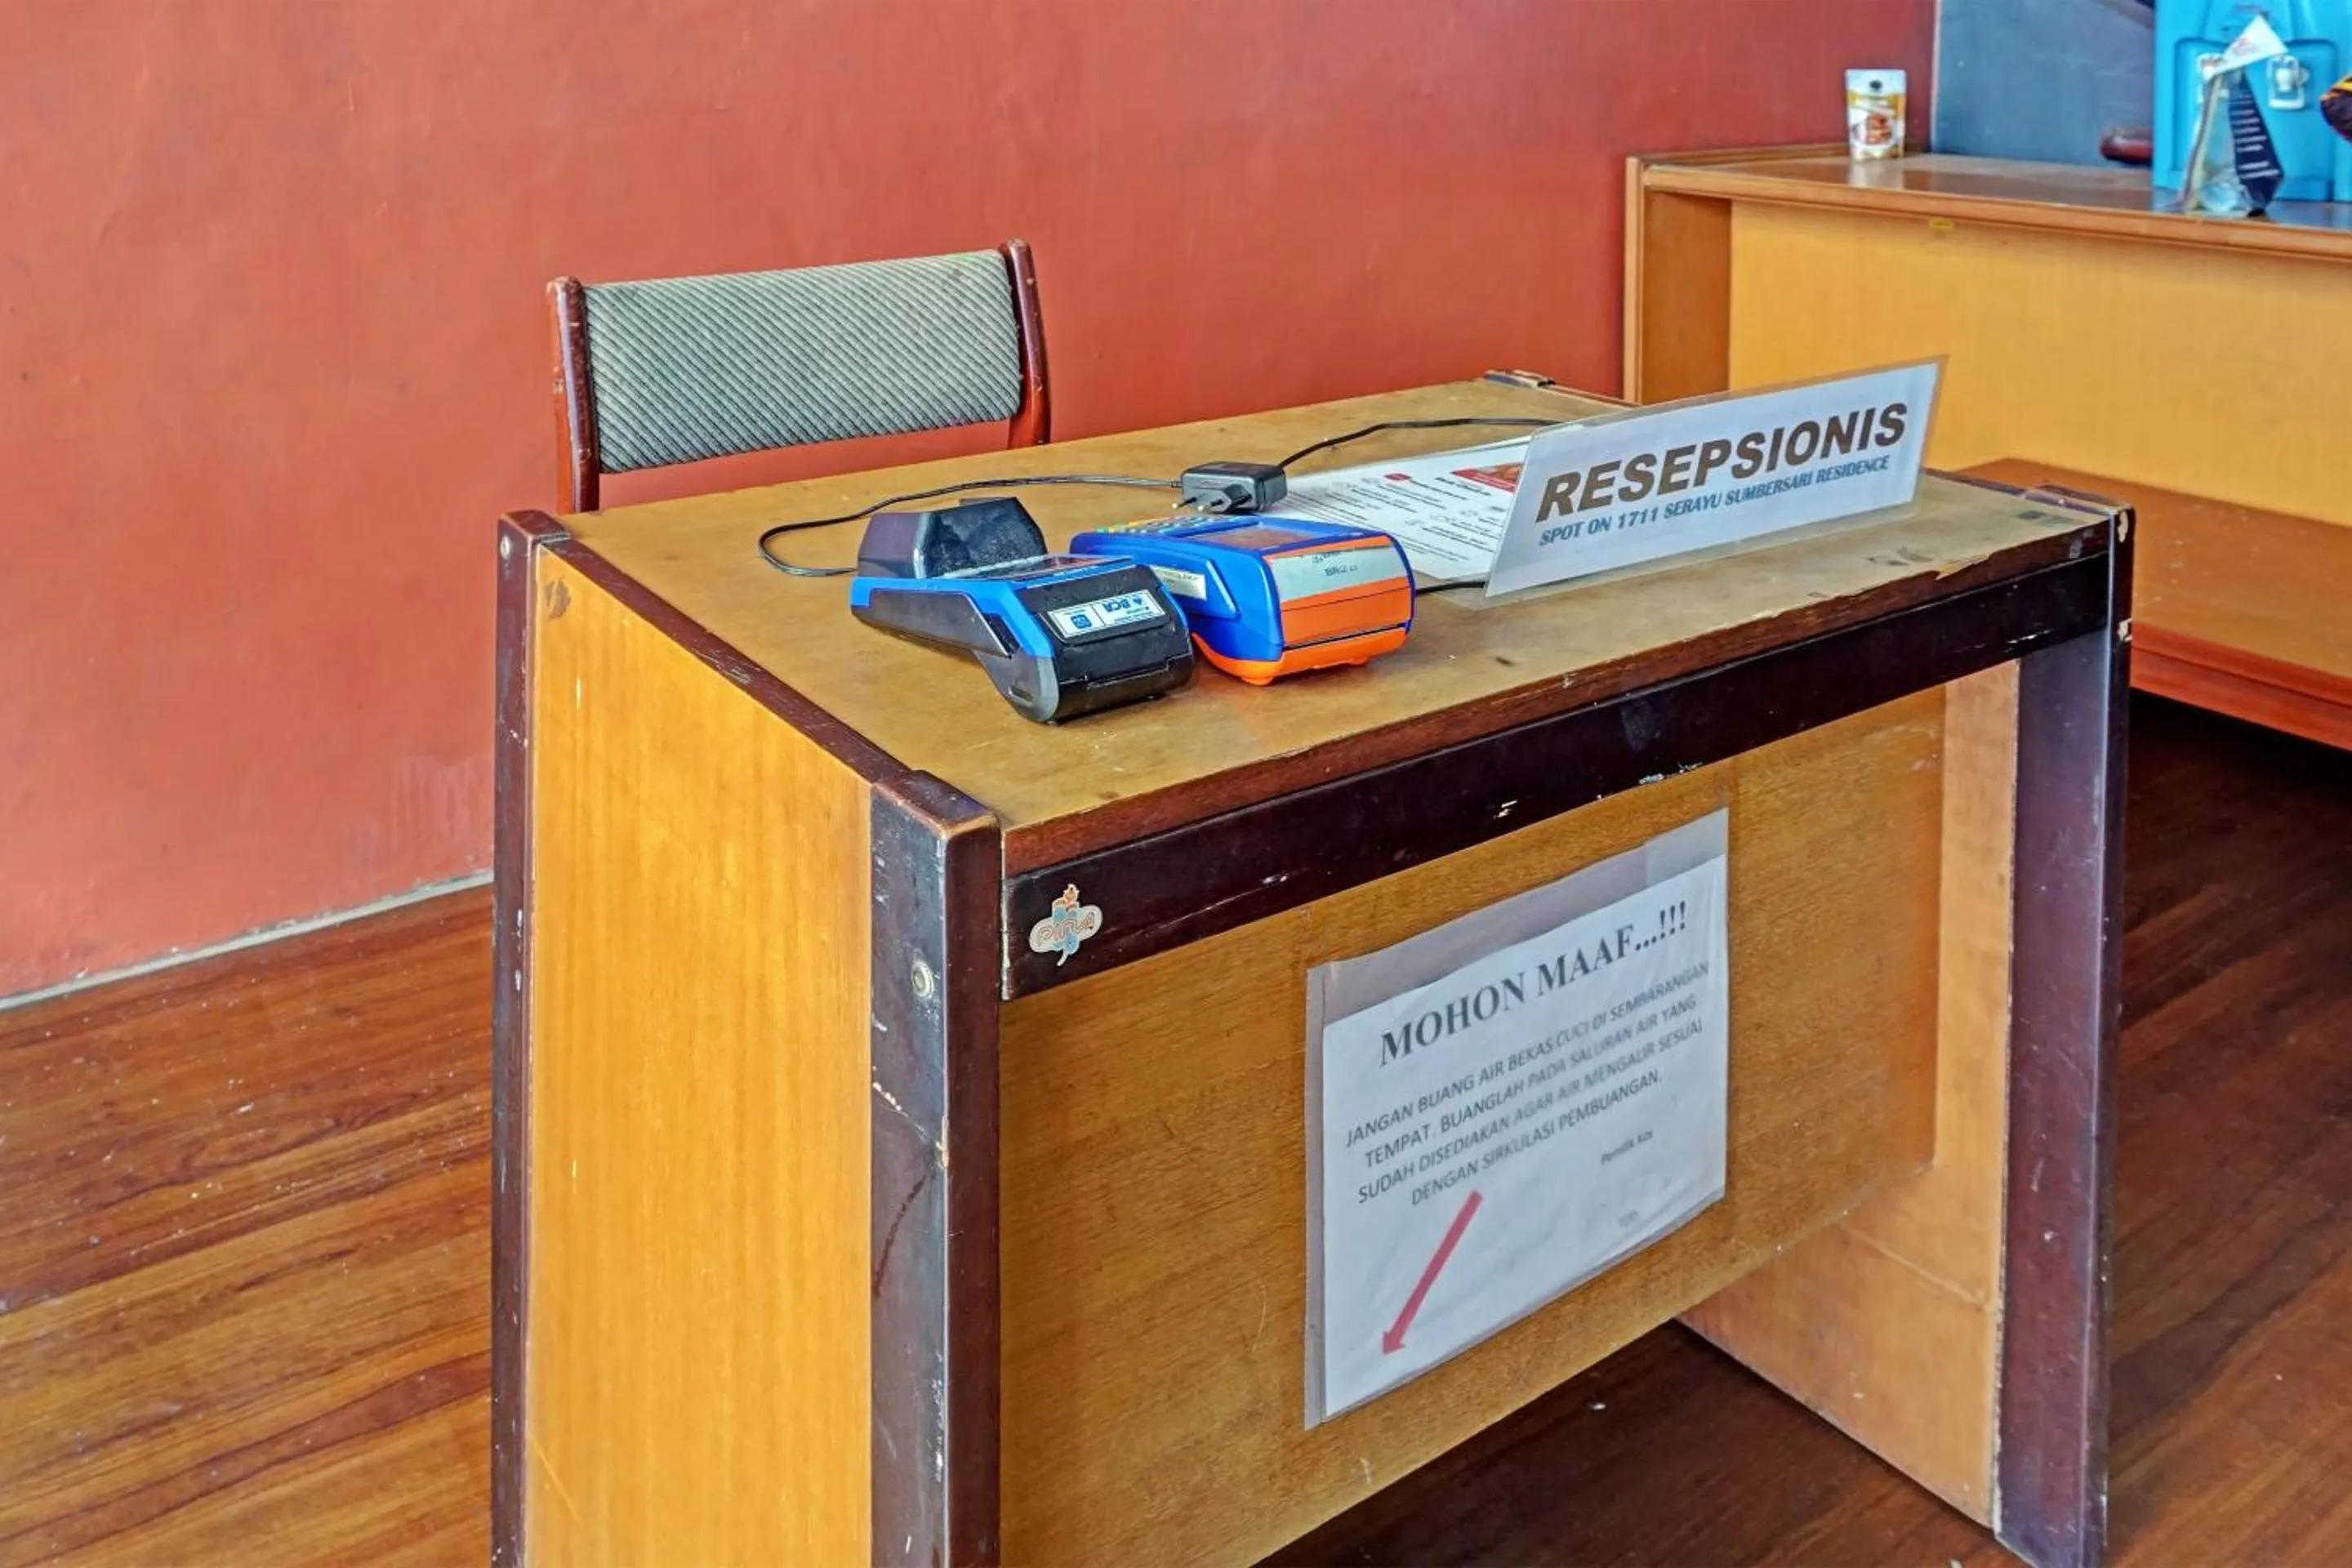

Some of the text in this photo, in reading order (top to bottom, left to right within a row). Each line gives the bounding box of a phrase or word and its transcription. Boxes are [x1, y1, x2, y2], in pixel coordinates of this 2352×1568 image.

[1535, 403, 1908, 523] RESEPSIONIS
[1539, 454, 1891, 546] SPOT ON 1711 SERAYU SUMBERSARI RESIDENCE
[1346, 960, 1709, 1147] JANGAN BUANG AIR BEKAS CUCI DI SEMBARANGAN
[1379, 972, 1525, 1067] MOHON
[1440, 1080, 1524, 1133] BUANGLAH
[1527, 1058, 1566, 1089] PADA
[1570, 1027, 1633, 1068] SALURAN
[1636, 1013, 1658, 1035] AIR
[1660, 993, 1696, 1022] YANG
[1358, 1018, 1703, 1204] SUDAH DISEDIAKAN AGAR AIR MENGALIR SESUAI
[1411, 1159, 1479, 1205] DENGAN
[1481, 1120, 1555, 1169] SIRKULASI
